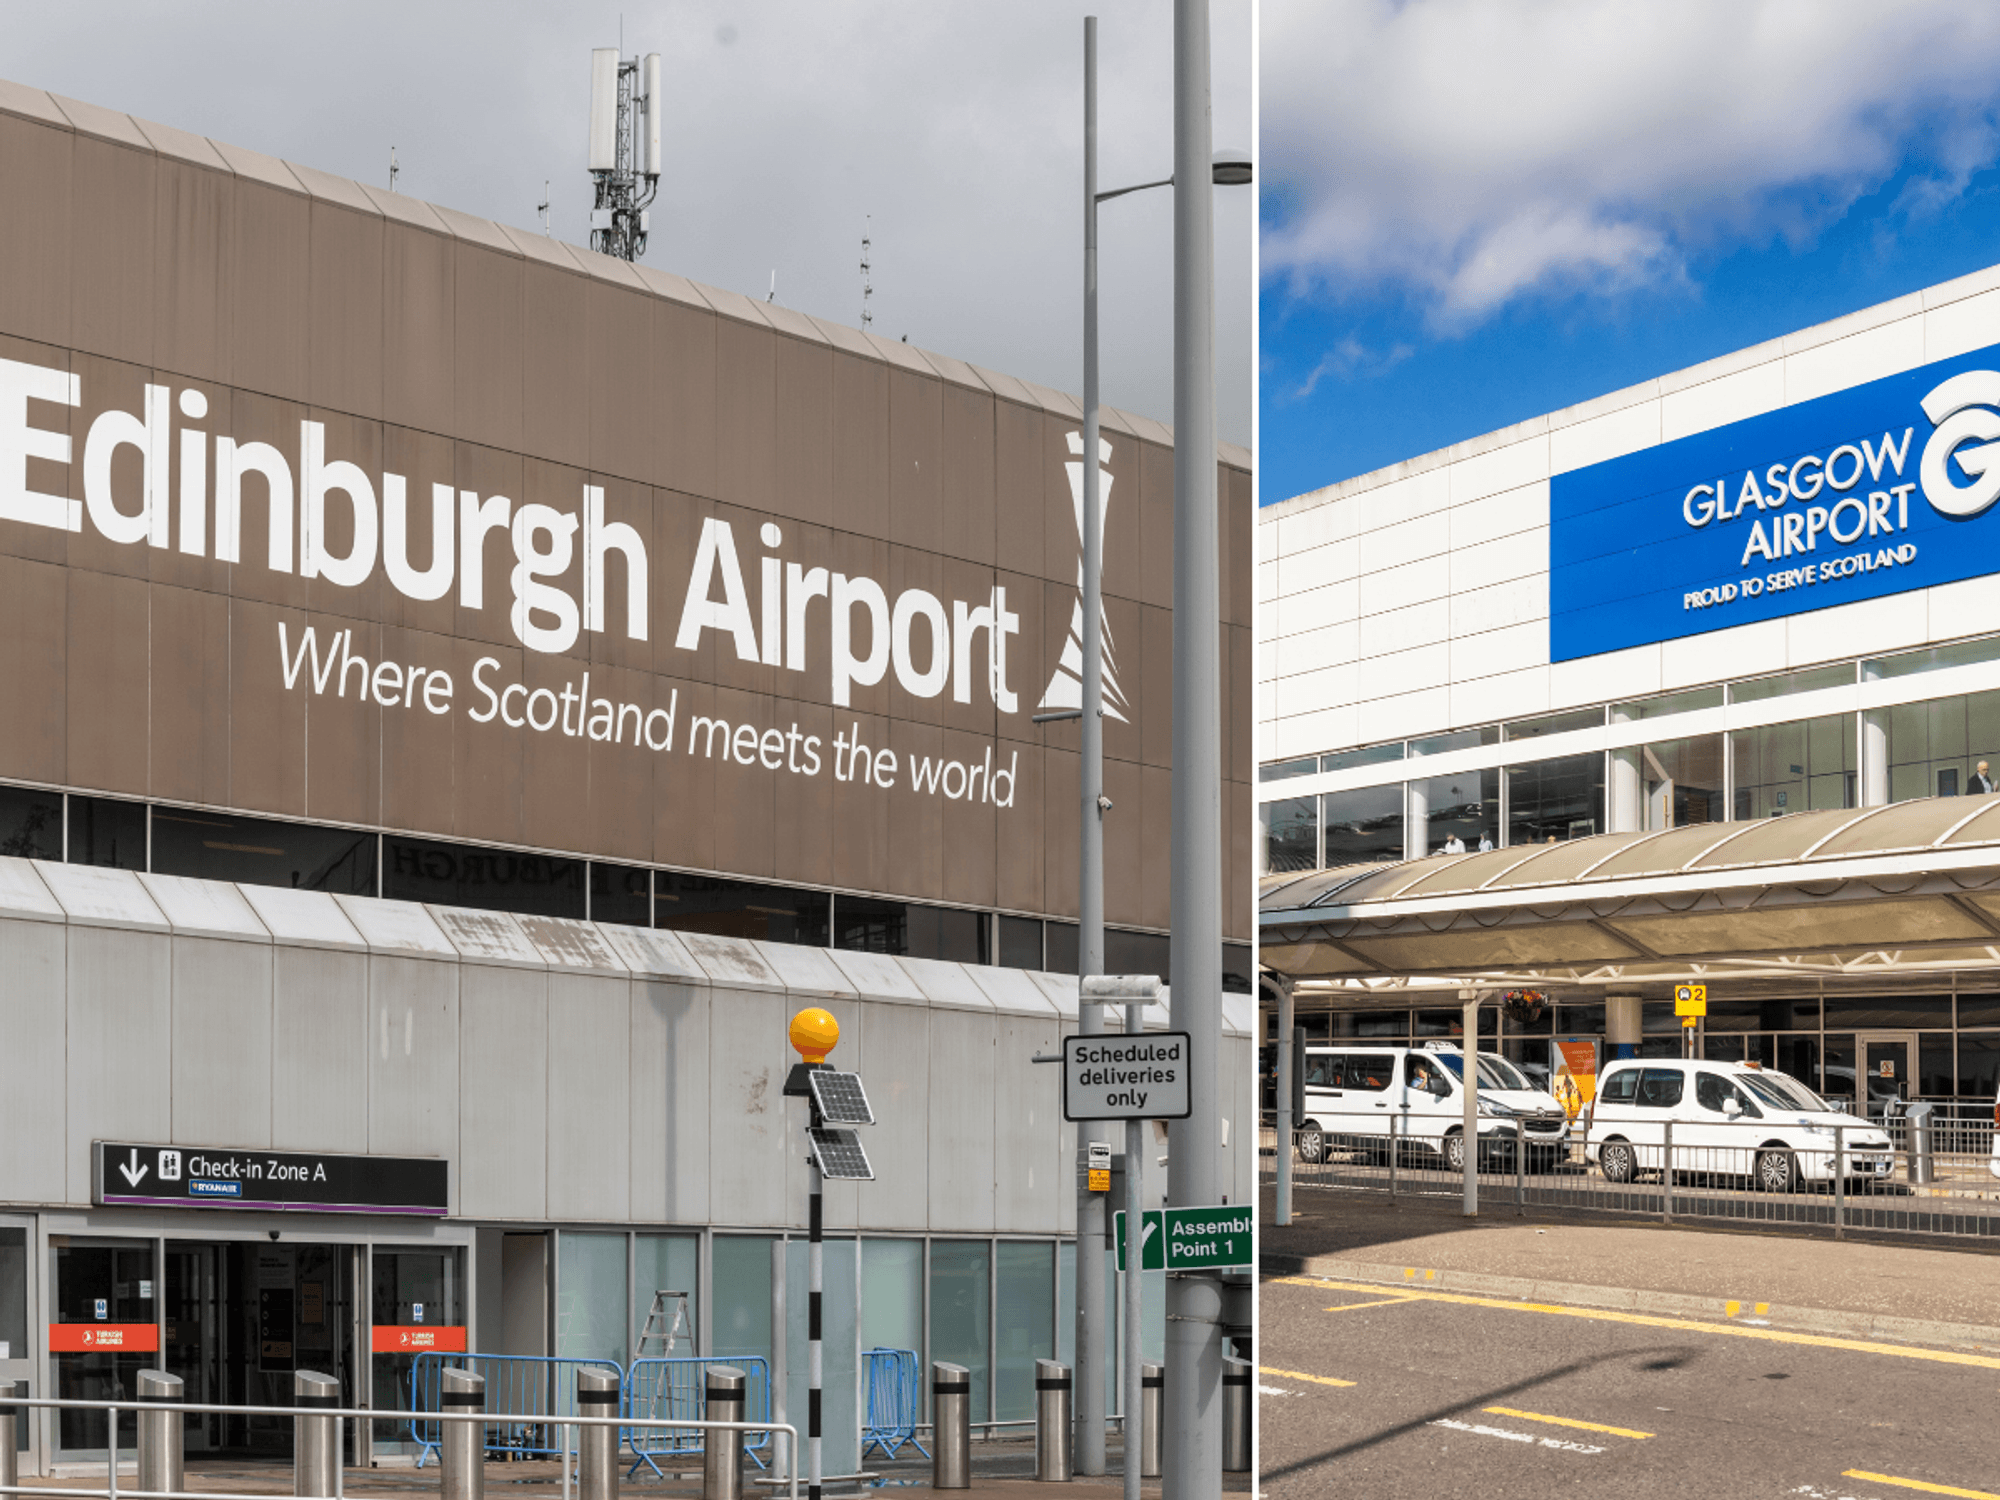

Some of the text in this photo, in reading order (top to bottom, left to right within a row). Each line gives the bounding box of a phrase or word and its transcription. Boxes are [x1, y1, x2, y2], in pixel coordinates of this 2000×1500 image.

[1684, 427, 1914, 528] GLASGOW
[0, 358, 1020, 714] Edinburgh Airport
[1740, 483, 1916, 566] AIRPORT
[1683, 543, 1917, 610] PROUD TO SERVE SCOTLAND
[278, 621, 1018, 808] Where Scotland meets the world
[1693, 988, 1703, 1002] 2
[1075, 1043, 1180, 1064] Scheduled
[1079, 1067, 1176, 1087] deliveries
[1106, 1088, 1148, 1109] only
[188, 1155, 327, 1182] Check-in Zone A
[198, 1183, 238, 1193] RYANAIR
[1172, 1239, 1233, 1258] Point 1
